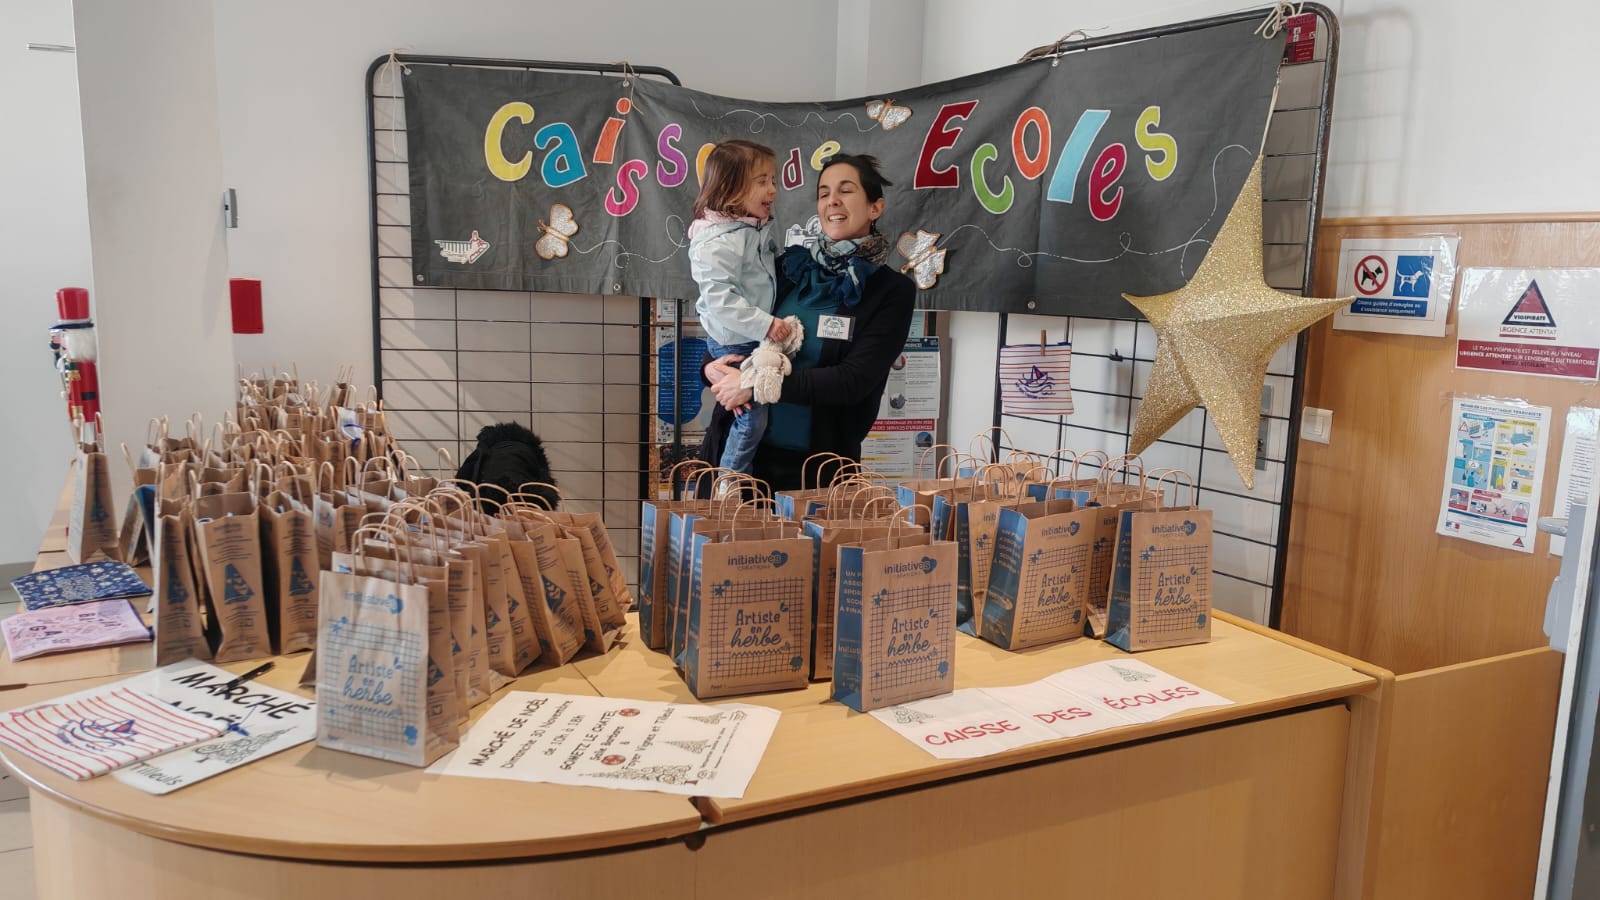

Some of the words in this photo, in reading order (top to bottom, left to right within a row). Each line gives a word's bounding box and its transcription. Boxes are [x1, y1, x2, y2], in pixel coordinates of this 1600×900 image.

[782, 140, 841, 190] de
[913, 99, 1178, 221] Ecoles
[1500, 326, 1528, 334] URGENCE
[1154, 587, 1191, 606] herbe
[735, 609, 781, 626] Artiste
[891, 617, 930, 635] Artiste
[730, 625, 782, 648] herbe
[750, 626, 762, 634] en
[903, 633, 914, 641] en
[887, 632, 931, 657] herbe
[348, 653, 394, 680] Artiste
[342, 675, 394, 706] herbe
[924, 719, 1021, 746] CAISSE
[1032, 706, 1093, 724] DES
[1103, 686, 1201, 711] ÉCOLES
[468, 730, 515, 767] MARCHÉ
[507, 717, 529, 729] DE
[500, 738, 537, 769] Dimanche
[530, 729, 547, 738] 30
[542, 700, 573, 729] Novembre
[550, 734, 567, 746] 10h
[544, 747, 557, 756] de
[559, 742, 591, 771] GOMETZ
[583, 733, 599, 743] LE
